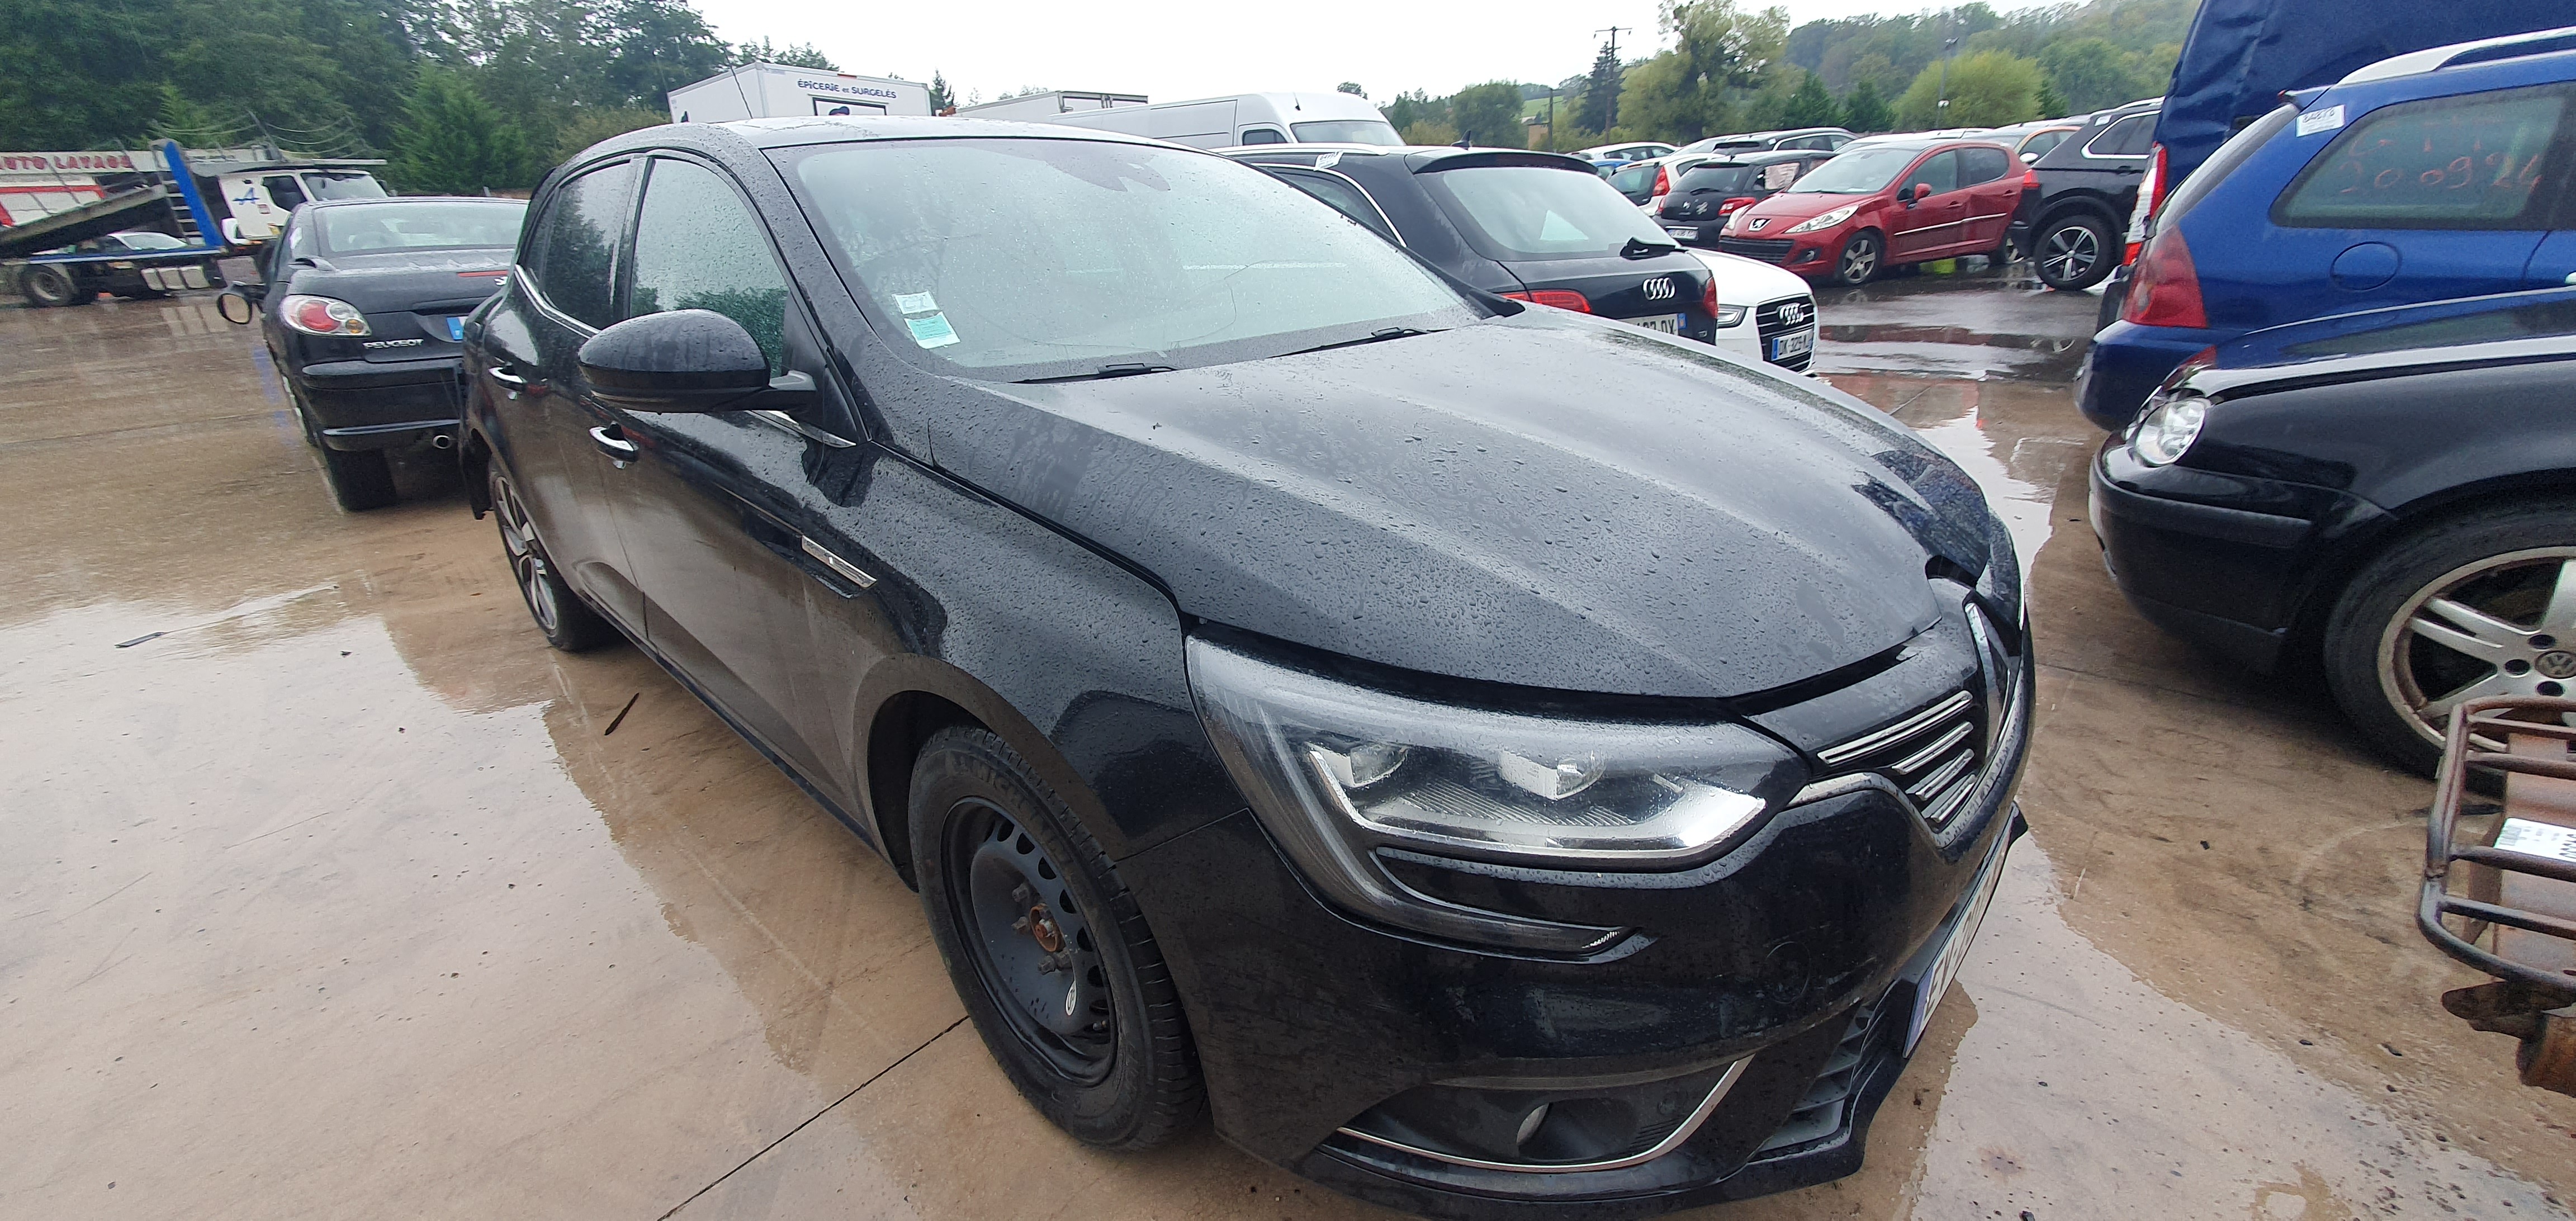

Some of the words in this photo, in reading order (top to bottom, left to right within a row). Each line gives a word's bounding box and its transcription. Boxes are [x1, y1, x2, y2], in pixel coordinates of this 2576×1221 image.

[851, 87, 897, 98] SURGELÉS
[0, 156, 46, 169] UTO
[362, 338, 424, 349] PEUGEOT
